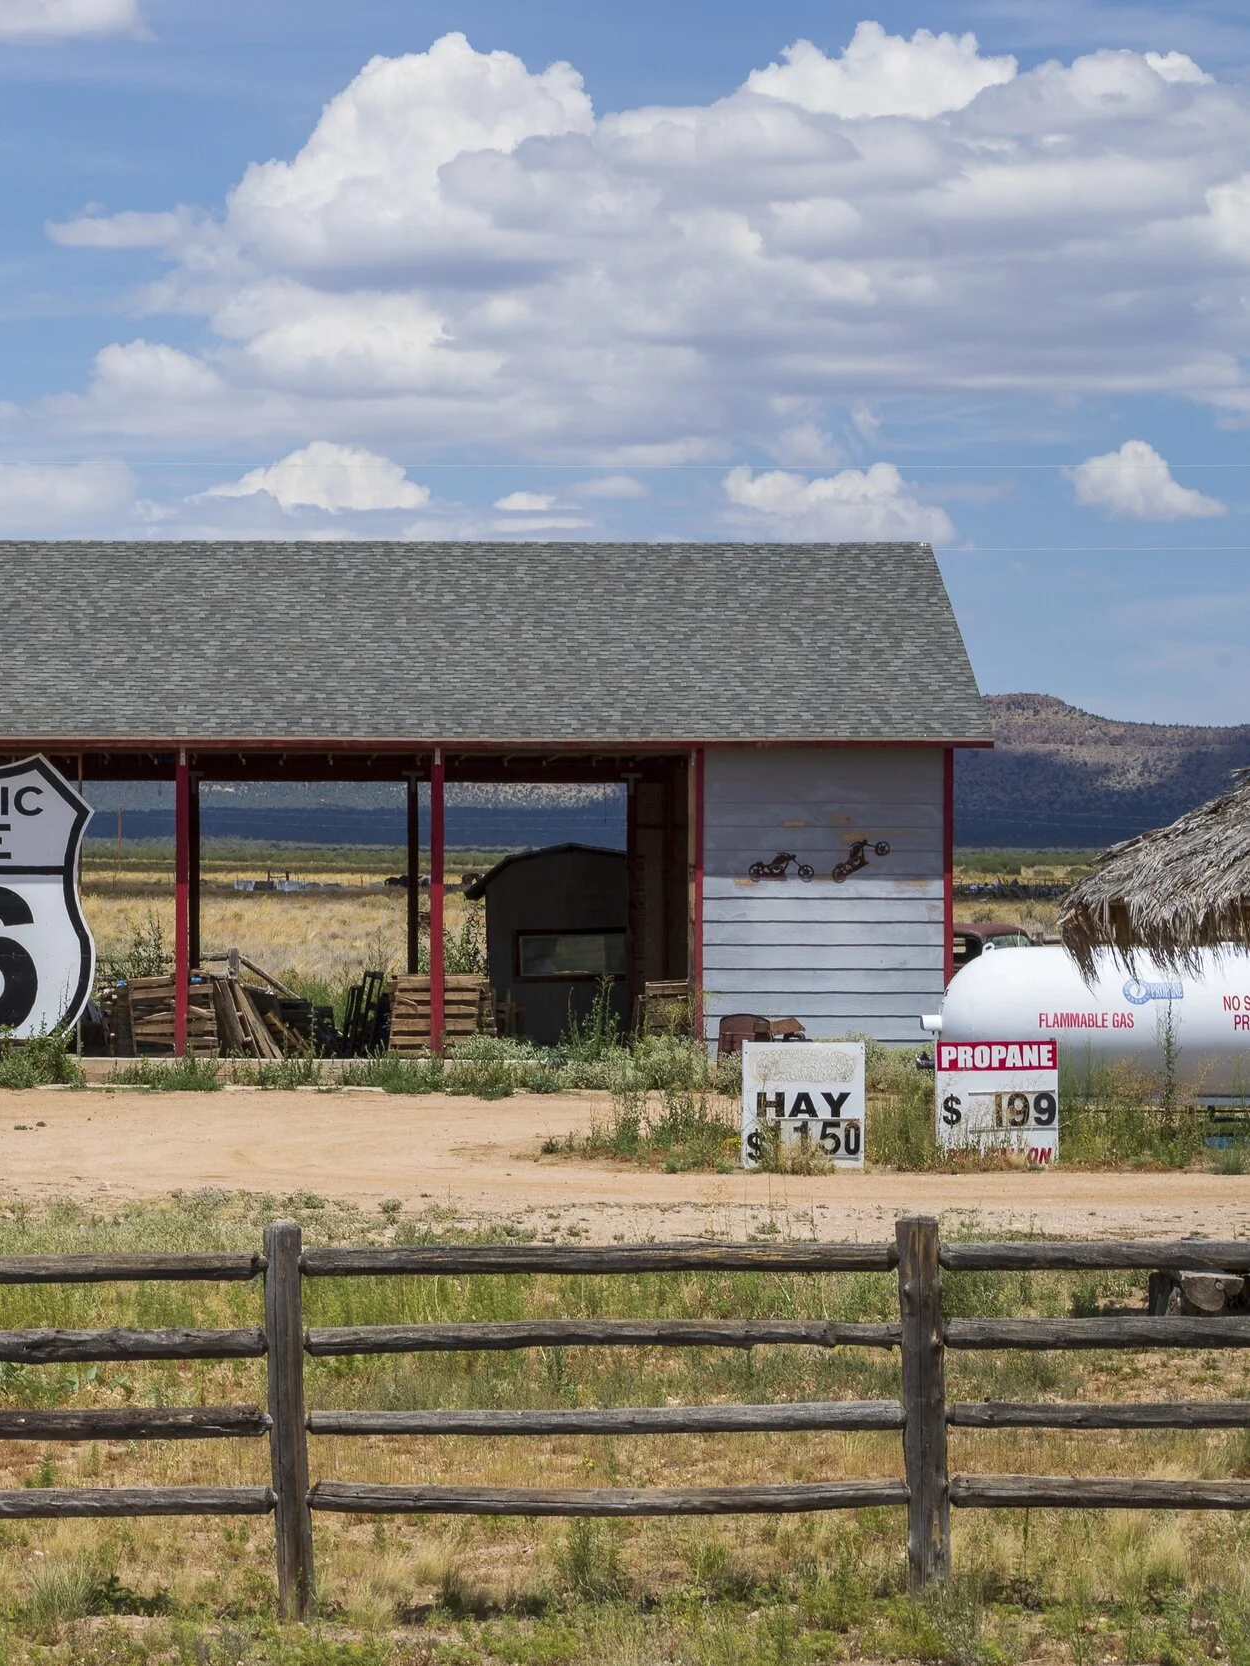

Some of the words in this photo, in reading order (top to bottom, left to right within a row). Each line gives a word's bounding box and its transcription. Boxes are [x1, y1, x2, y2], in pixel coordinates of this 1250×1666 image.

[1223, 995, 1240, 1011] NO
[1039, 1012, 1109, 1029] FLAMMABLE
[1112, 1012, 1135, 1029] GAS
[941, 1045, 1053, 1068] PROPANE
[757, 1092, 851, 1118] HAY
